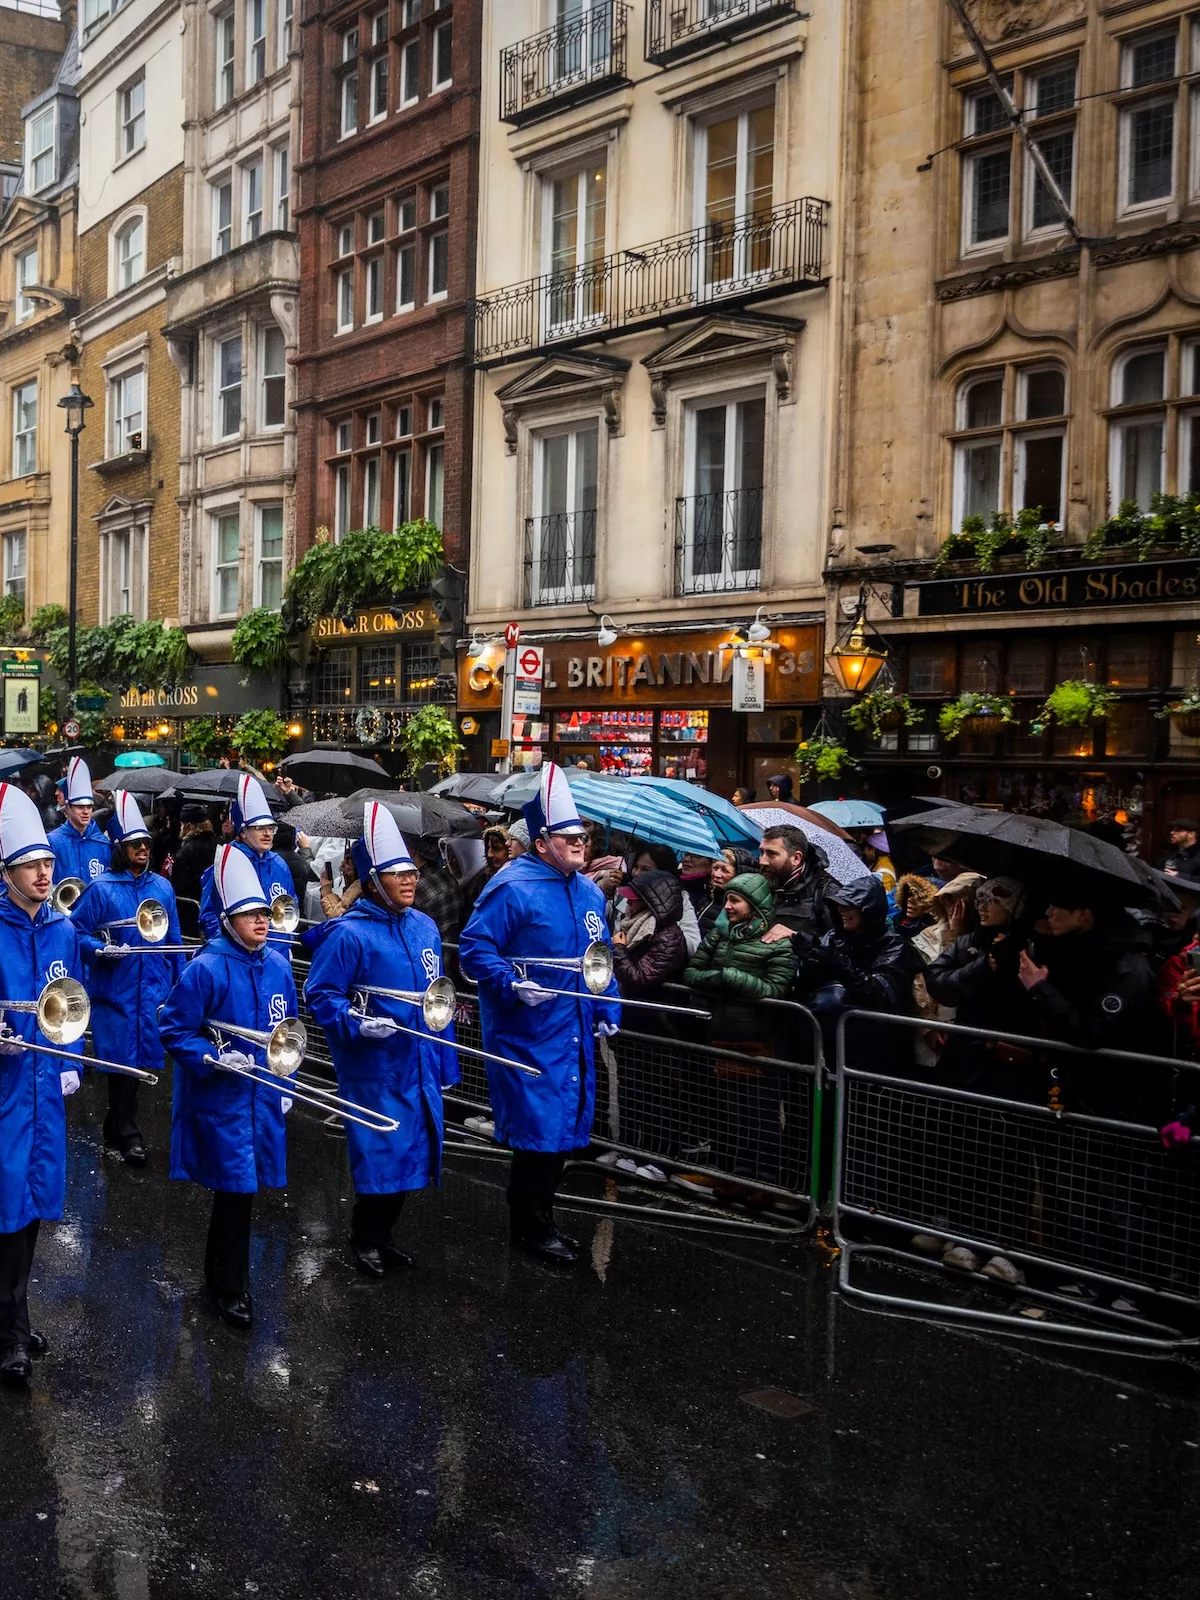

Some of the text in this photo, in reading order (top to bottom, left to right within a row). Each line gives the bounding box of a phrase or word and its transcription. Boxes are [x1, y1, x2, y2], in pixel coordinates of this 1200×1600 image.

[954, 568, 1197, 608] The Old Shades
[373, 609, 425, 632] CROSS
[507, 626, 519, 641] M
[778, 651, 815, 675] 35
